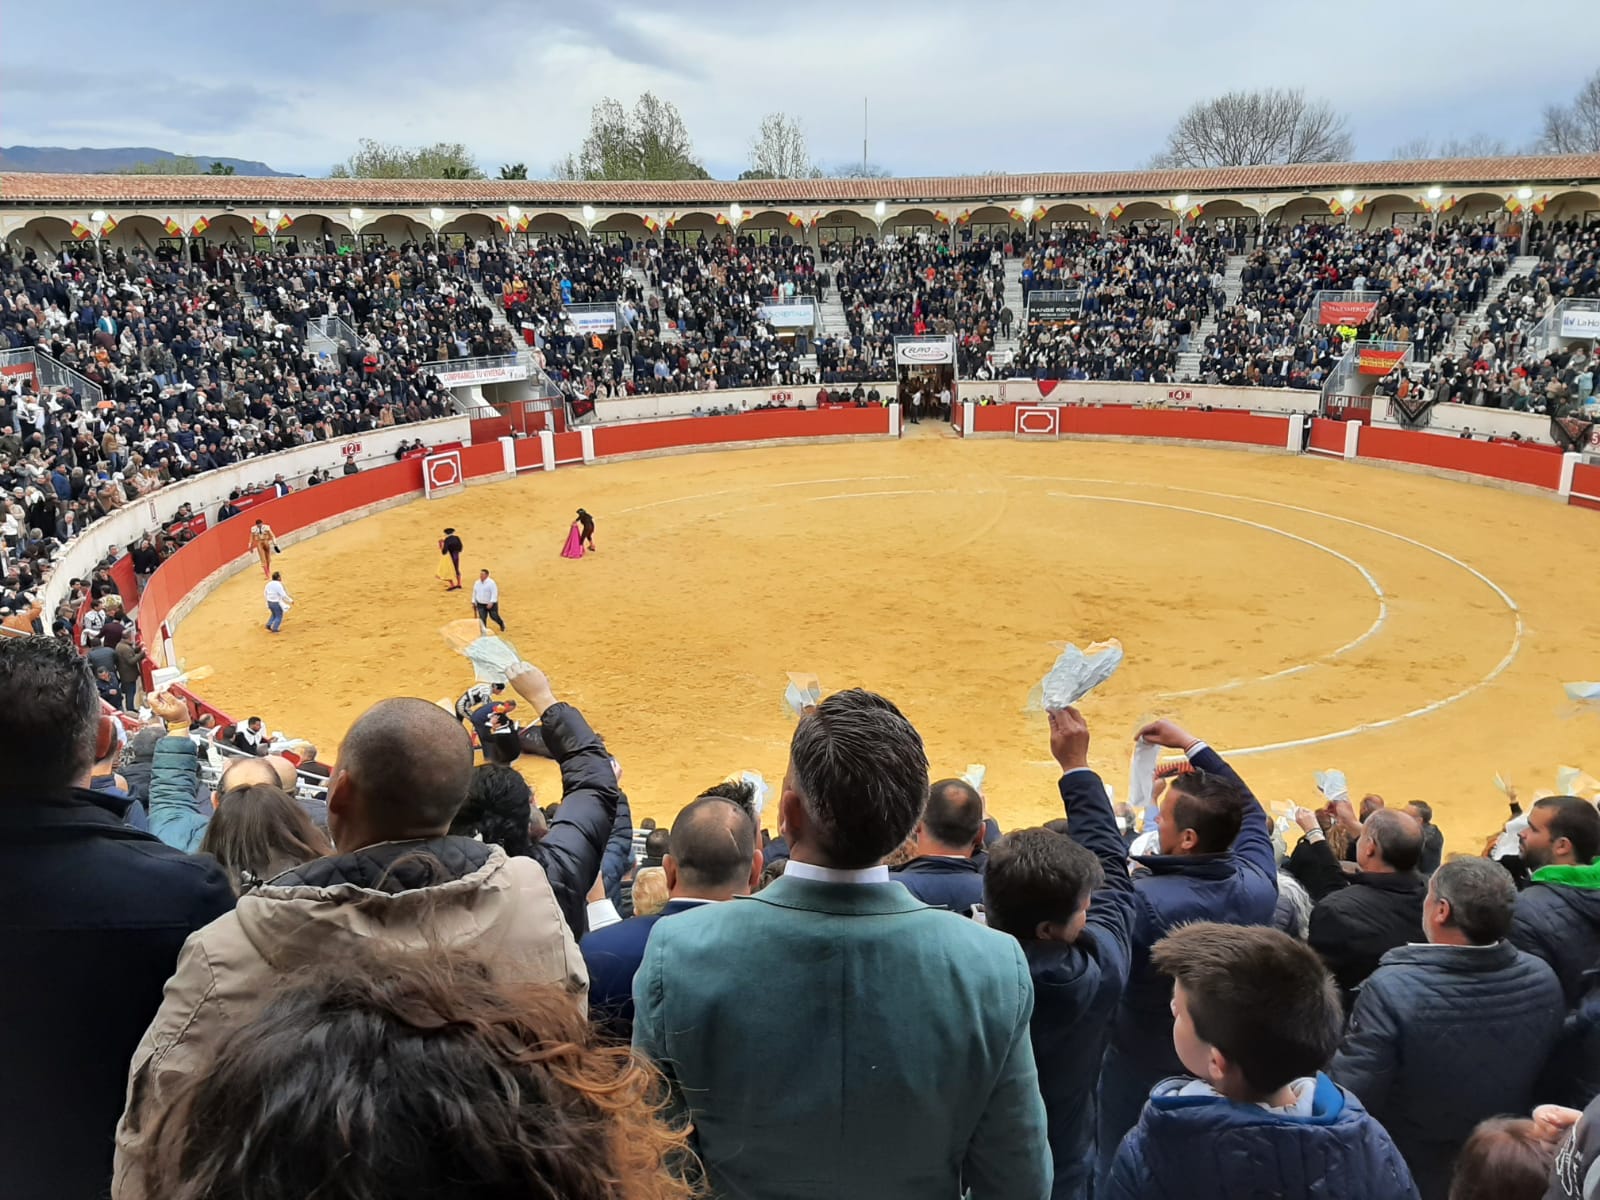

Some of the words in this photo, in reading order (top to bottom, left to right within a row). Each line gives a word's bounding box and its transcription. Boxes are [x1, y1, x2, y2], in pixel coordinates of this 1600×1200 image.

[443, 370, 475, 381] COMPRAMOS
[483, 368, 506, 378] VIVIENDA
[778, 393, 785, 401] 3
[1175, 391, 1182, 400] 4
[1591, 433, 1599, 444] 5
[348, 443, 355, 454] 2
